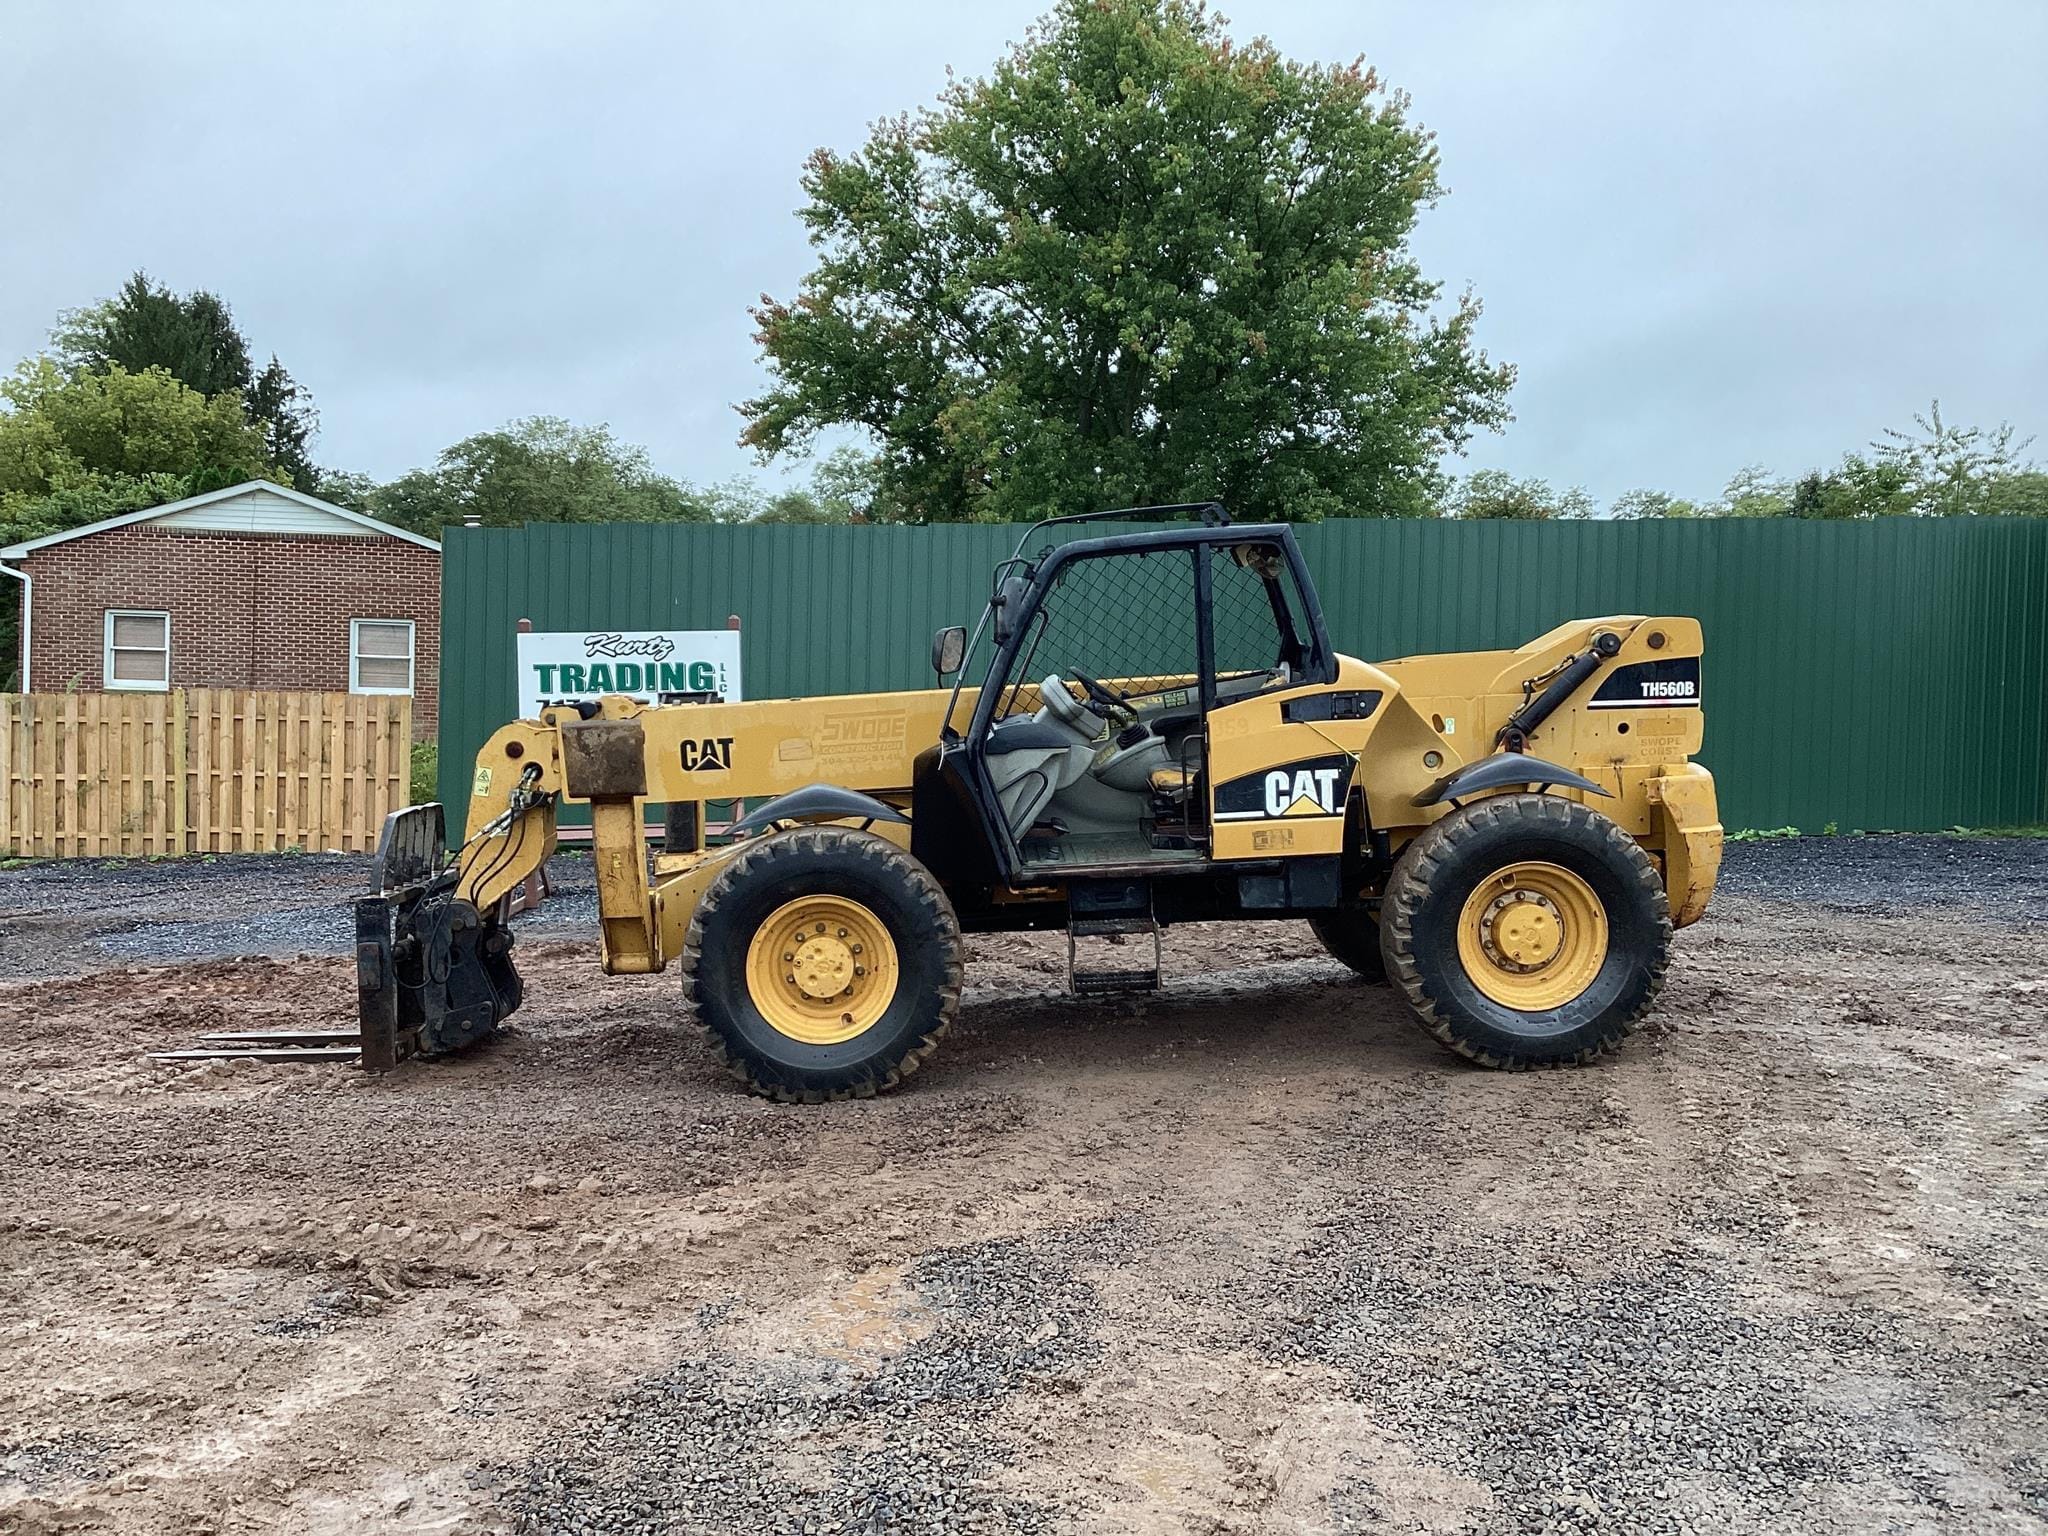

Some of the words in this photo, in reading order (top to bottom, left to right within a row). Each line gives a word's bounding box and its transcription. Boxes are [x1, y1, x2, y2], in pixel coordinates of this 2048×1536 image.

[584, 634, 674, 661] Kurtz
[533, 661, 716, 694] TRADING
[719, 662, 728, 693] LLC
[1641, 681, 1695, 697] TH560B
[680, 737, 734, 772] CAT
[1265, 768, 1339, 816] CAT
